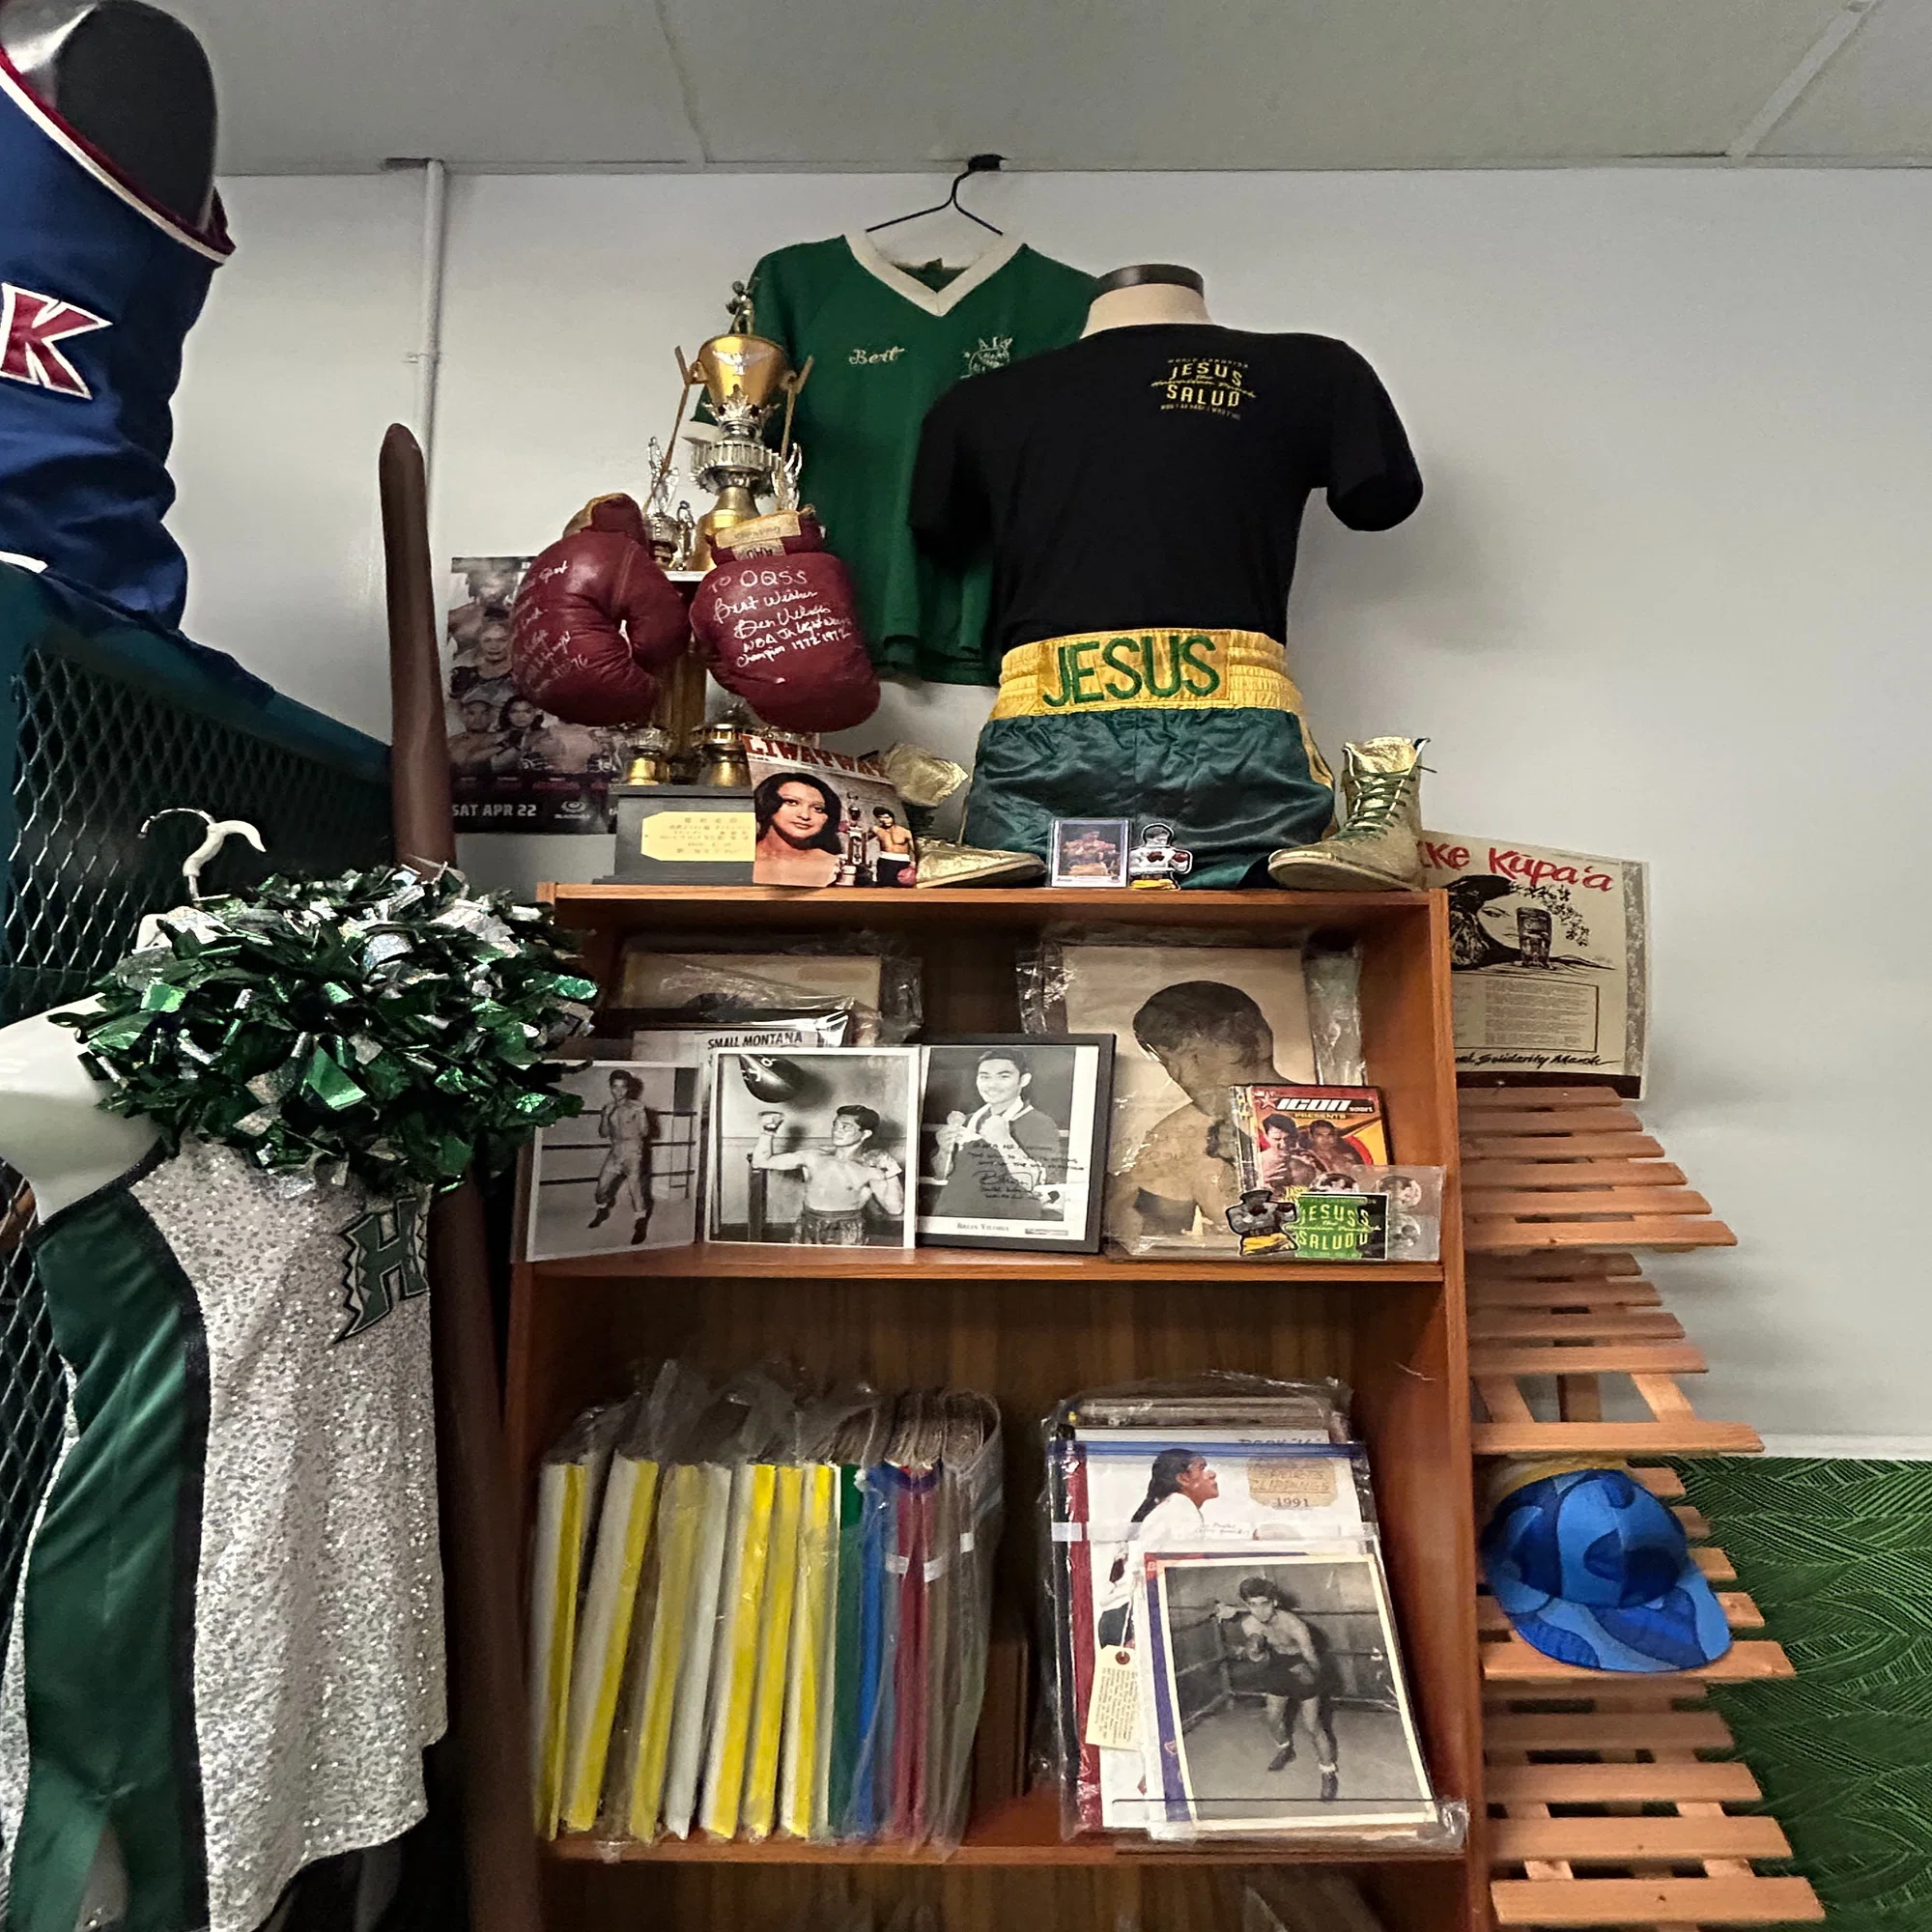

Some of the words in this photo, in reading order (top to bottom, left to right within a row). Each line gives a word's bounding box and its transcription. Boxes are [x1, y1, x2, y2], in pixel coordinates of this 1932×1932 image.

[848, 345, 905, 365] Bert
[1168, 361, 1243, 387] JESUS
[1166, 384, 1240, 407] SALUD
[1041, 634, 1221, 708] JESUS
[452, 804, 478, 817] SAT
[483, 804, 514, 817] APR
[517, 804, 537, 817] 22
[707, 1036, 740, 1050] SMALL
[742, 1031, 804, 1047] MONTANA
[1298, 1205, 1356, 1227] JESUS
[1298, 1230, 1354, 1251] SALUD
[1275, 1496, 1310, 1508] 1991
